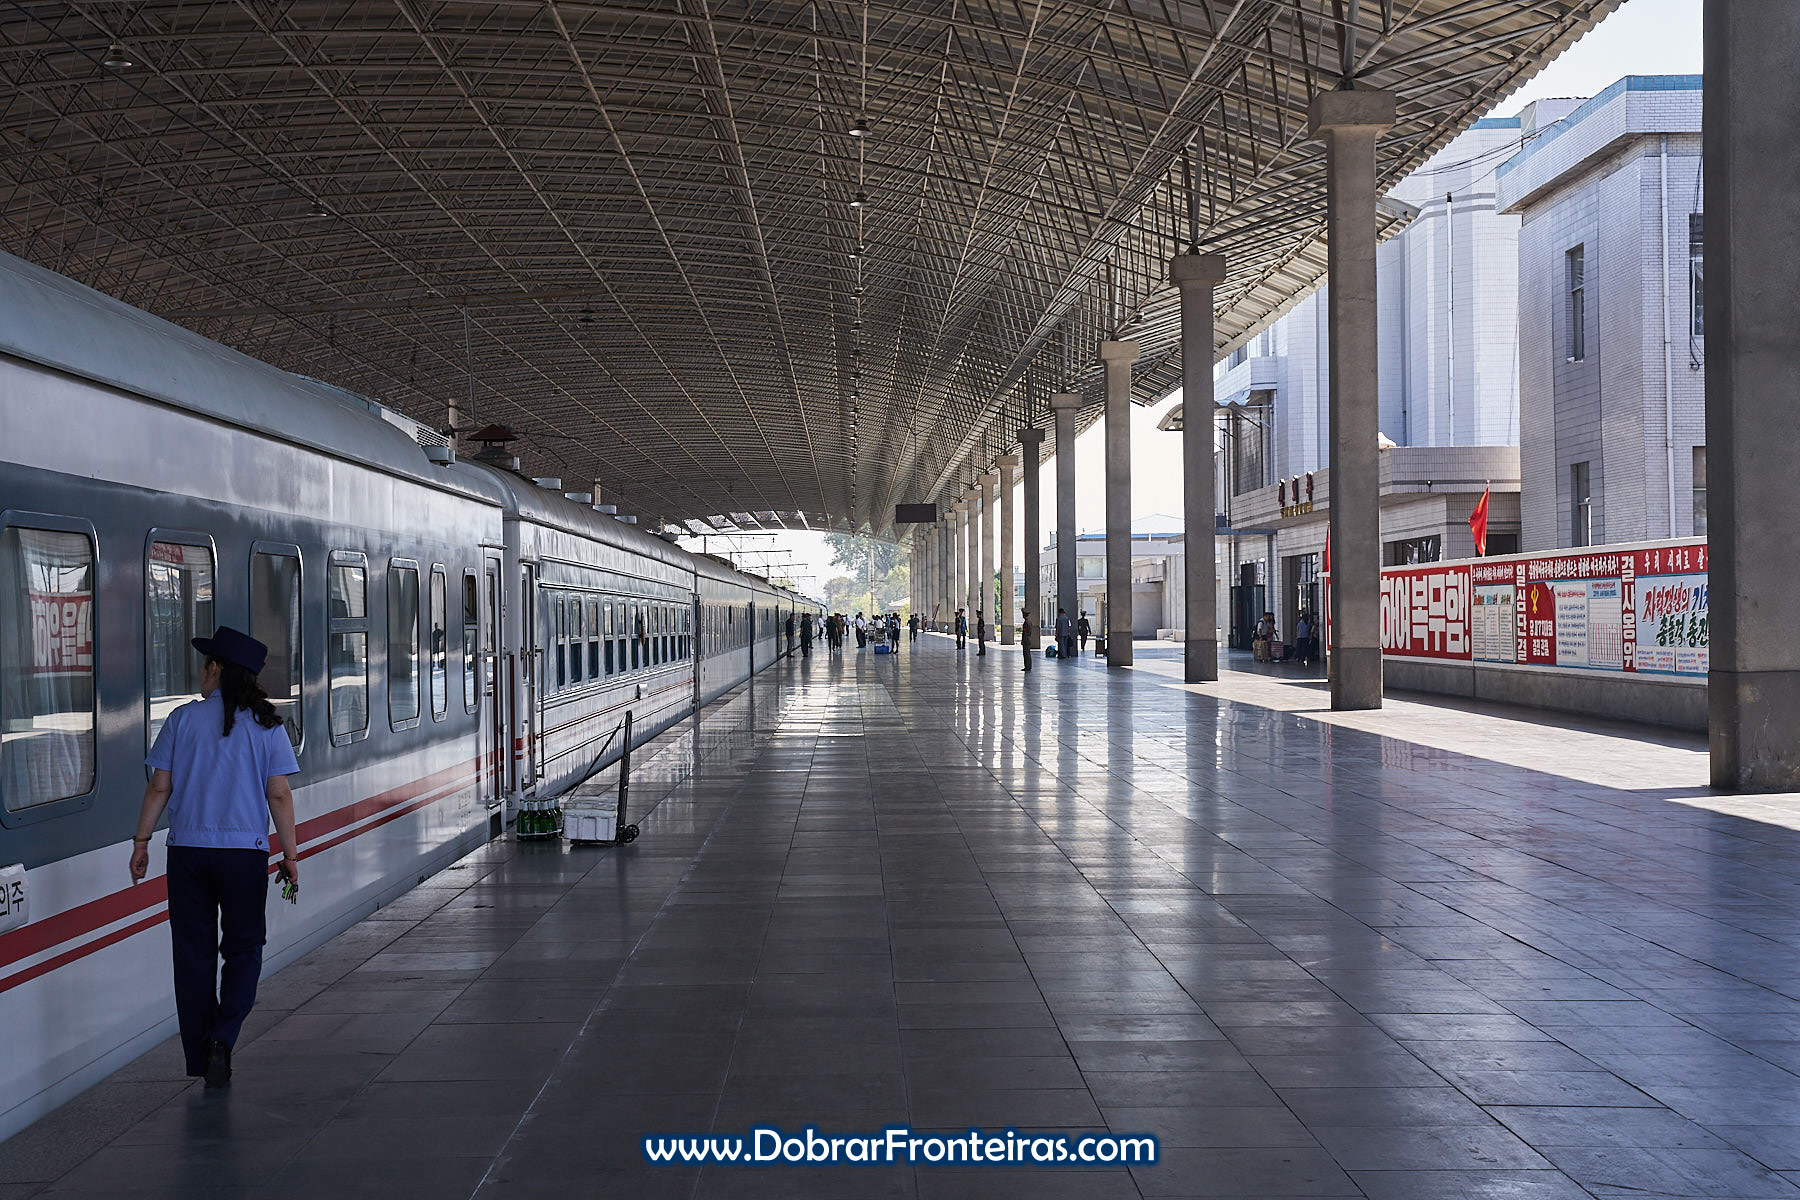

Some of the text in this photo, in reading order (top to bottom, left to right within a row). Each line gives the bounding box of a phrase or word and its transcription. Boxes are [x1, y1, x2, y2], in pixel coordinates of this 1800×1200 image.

[1644, 550, 1660, 574] 우리
[1411, 569, 1470, 654] 복무함!
[1516, 564, 1528, 661] 일심단결
[1642, 582, 1691, 623] 자력갱생의
